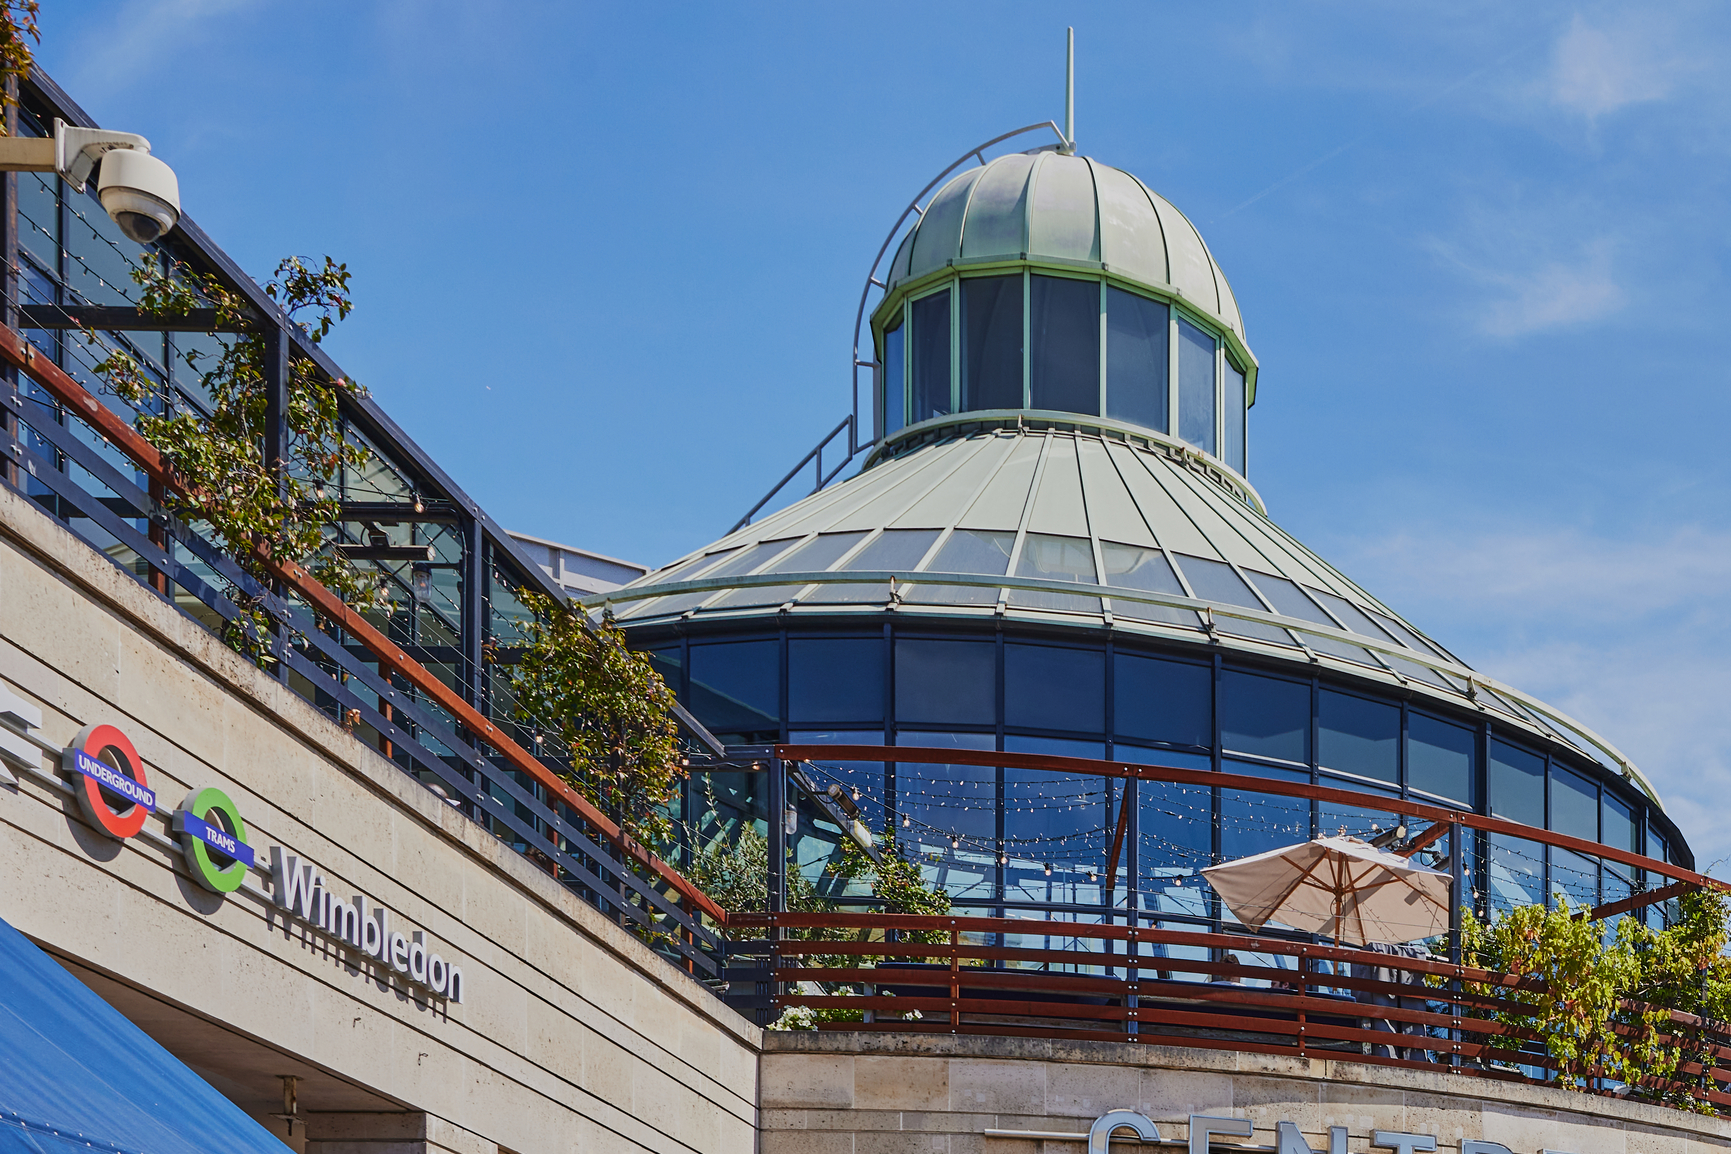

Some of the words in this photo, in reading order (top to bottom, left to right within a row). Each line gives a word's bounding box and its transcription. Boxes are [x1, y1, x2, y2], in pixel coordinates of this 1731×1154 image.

[78, 754, 154, 807] UNDERGROUND
[205, 826, 236, 854] TRAMS
[274, 845, 464, 1005] Wimbledon
